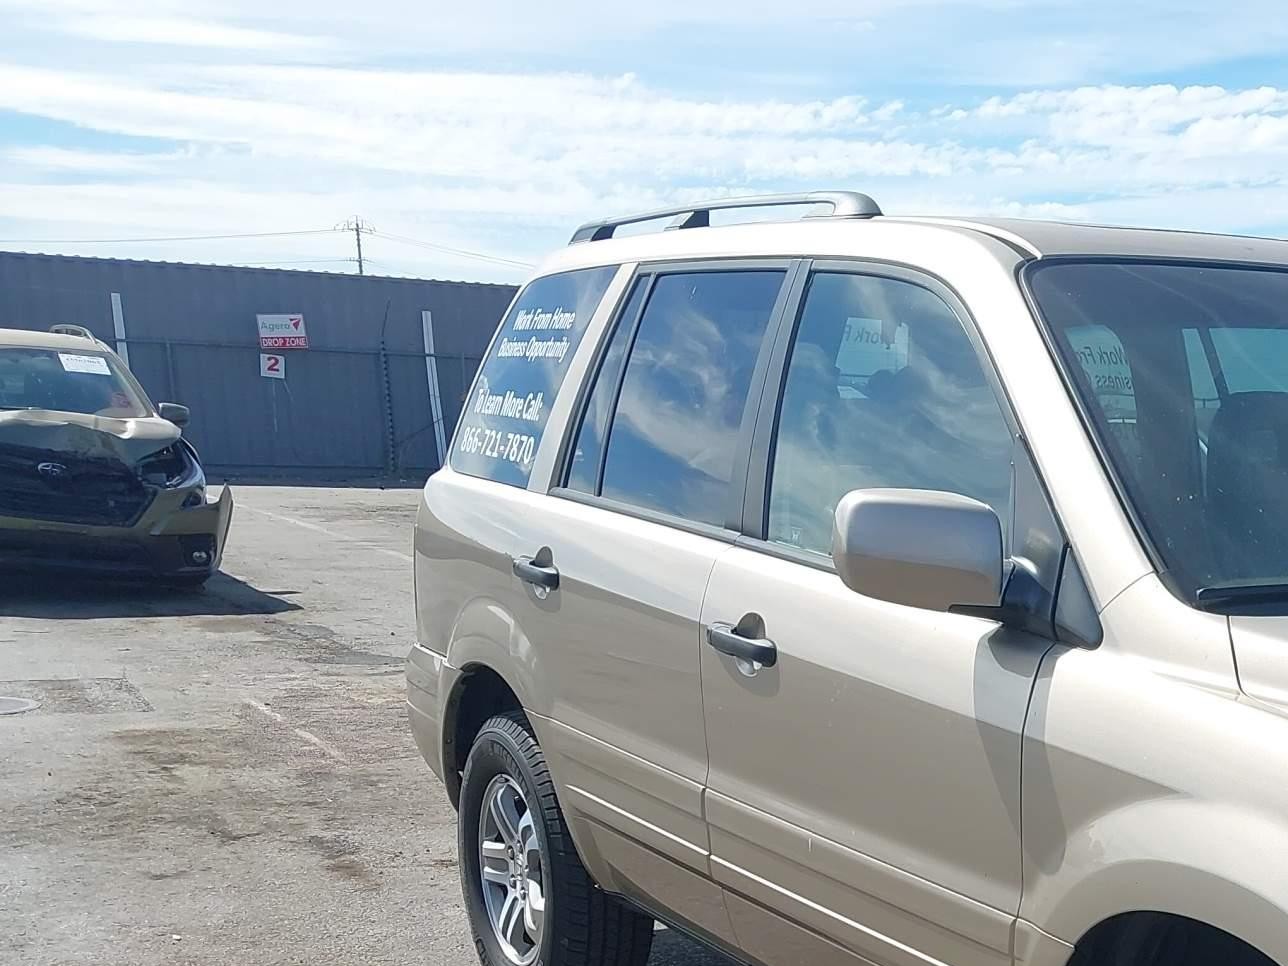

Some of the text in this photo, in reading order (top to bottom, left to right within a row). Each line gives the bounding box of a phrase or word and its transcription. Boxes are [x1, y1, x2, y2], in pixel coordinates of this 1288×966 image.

[260, 320, 290, 333] Agero
[512, 306, 576, 331] Work From Home
[262, 337, 307, 347] DROP ZONE
[497, 336, 571, 363] Business Opportunity
[266, 356, 280, 372] 2
[474, 388, 544, 422] To Learn More Call:
[460, 426, 535, 465] 866-721-7870
